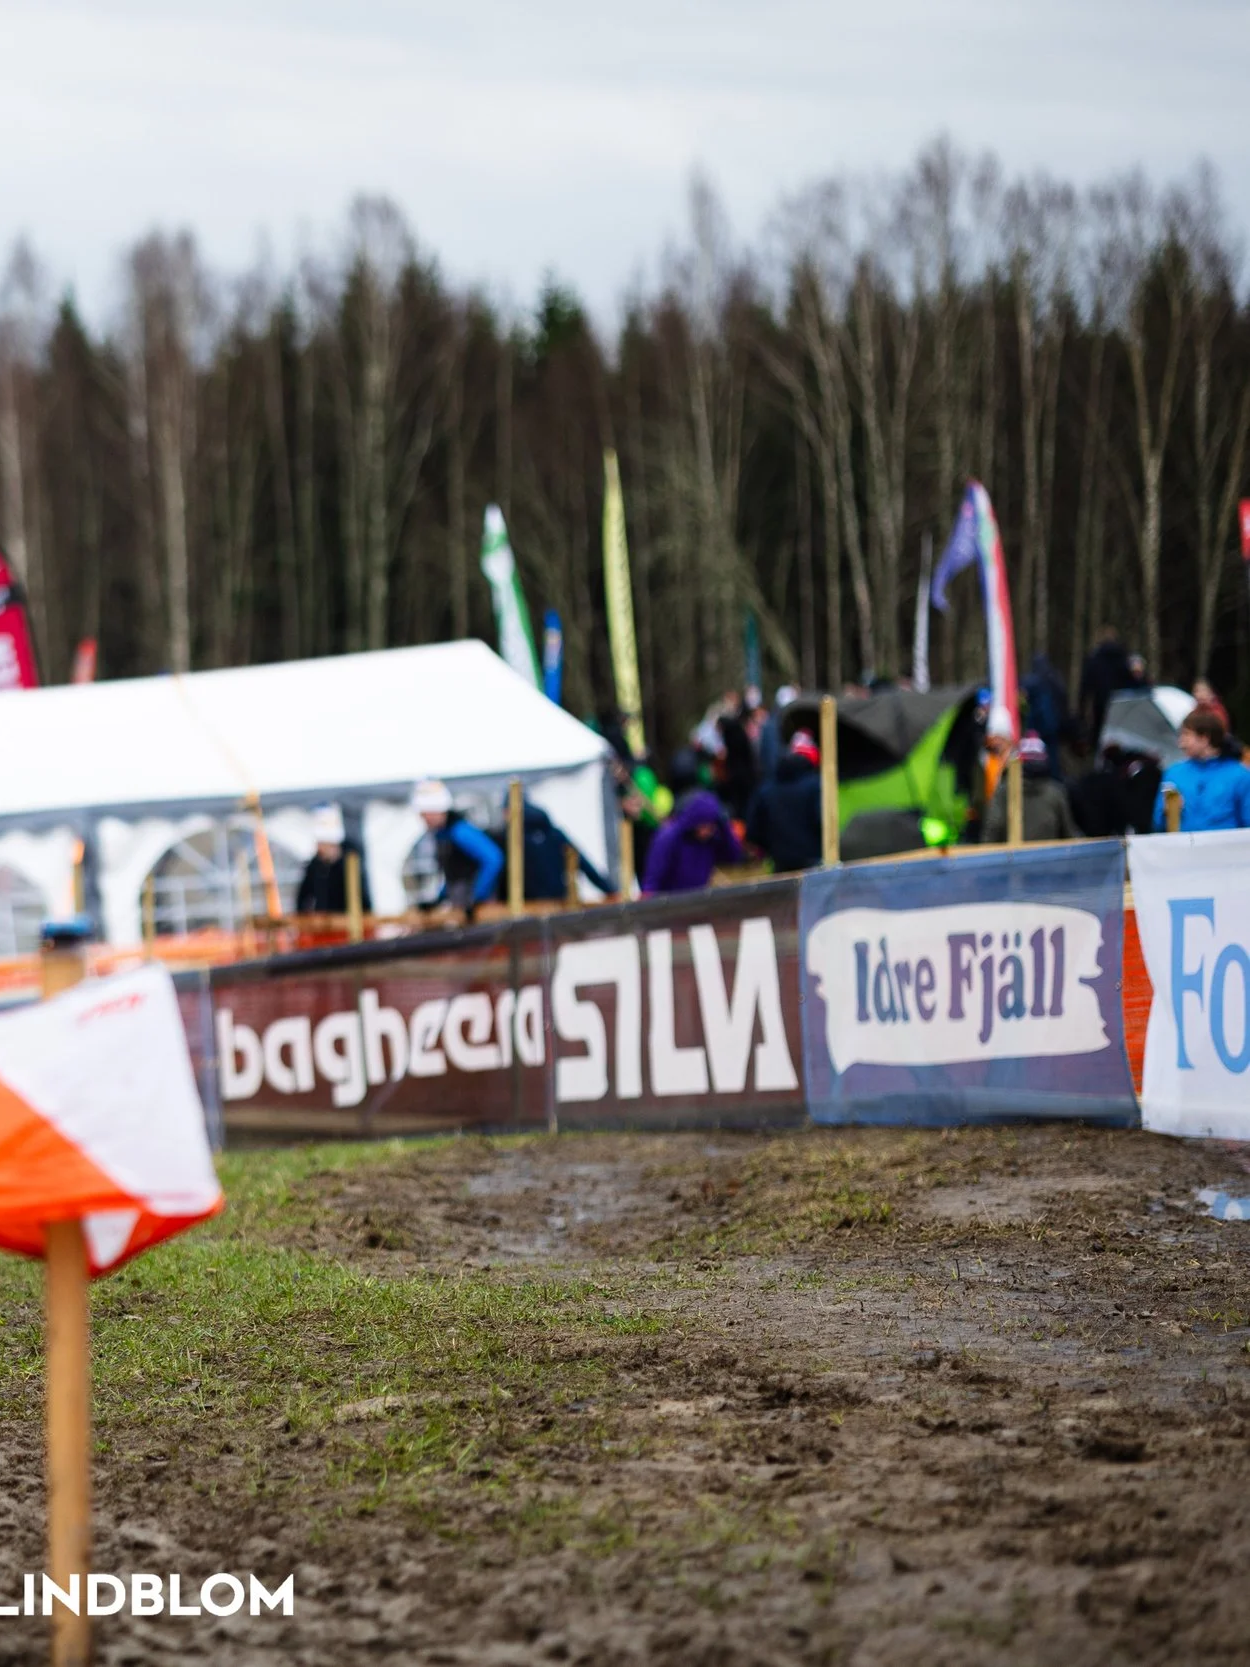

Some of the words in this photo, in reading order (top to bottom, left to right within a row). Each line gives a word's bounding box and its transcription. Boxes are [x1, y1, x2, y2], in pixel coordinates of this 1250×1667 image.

[855, 937, 935, 1024] Idre
[948, 926, 1064, 1043] Fjäll
[217, 988, 544, 1108] bagheera
